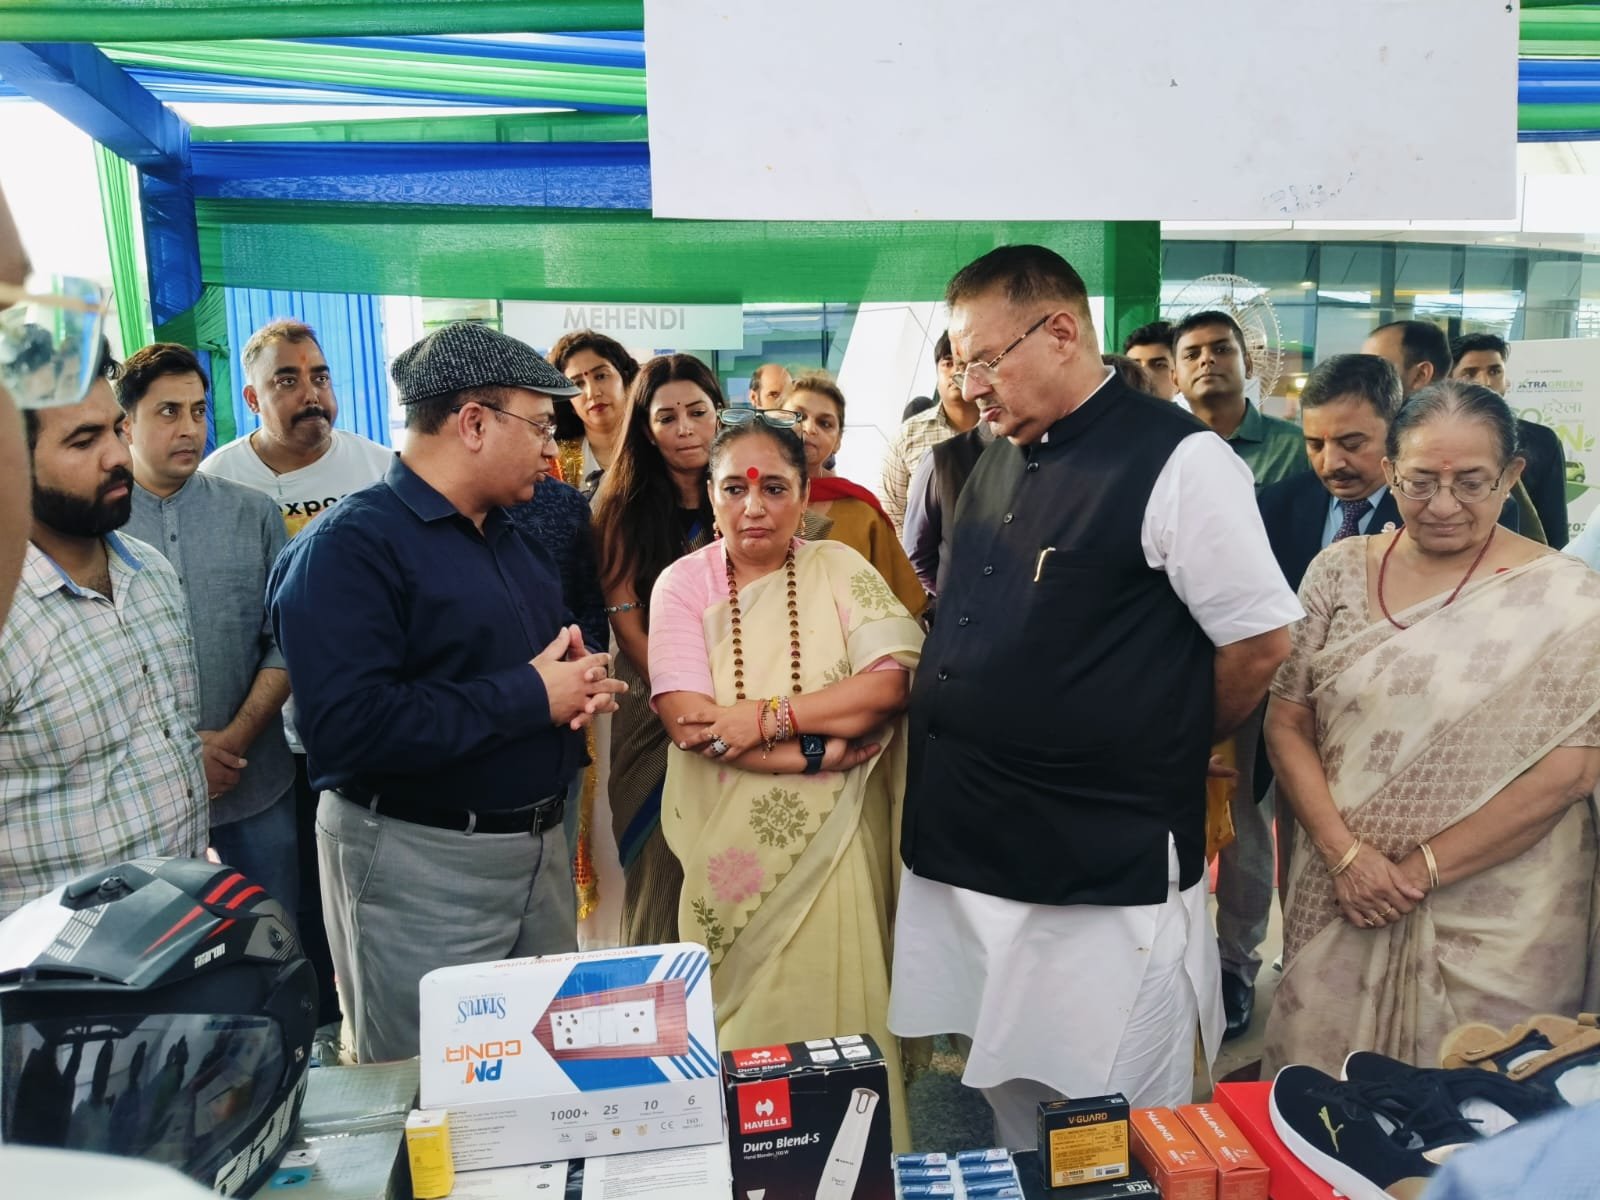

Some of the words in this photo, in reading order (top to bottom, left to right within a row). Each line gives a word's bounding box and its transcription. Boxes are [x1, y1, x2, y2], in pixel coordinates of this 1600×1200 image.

[563, 306, 685, 330] MEHENDI
[457, 997, 507, 1024] STATUS
[445, 1040, 522, 1063] CONA
[465, 1059, 503, 1085] PM
[550, 1108, 589, 1121] 1000+
[602, 1104, 619, 1116] 25
[643, 1099, 659, 1111] 10
[688, 1095, 696, 1105] 6
[744, 1117, 787, 1130] HAVELLS
[742, 1140, 773, 1153] Duro
[776, 1132, 821, 1149] Blend-S
